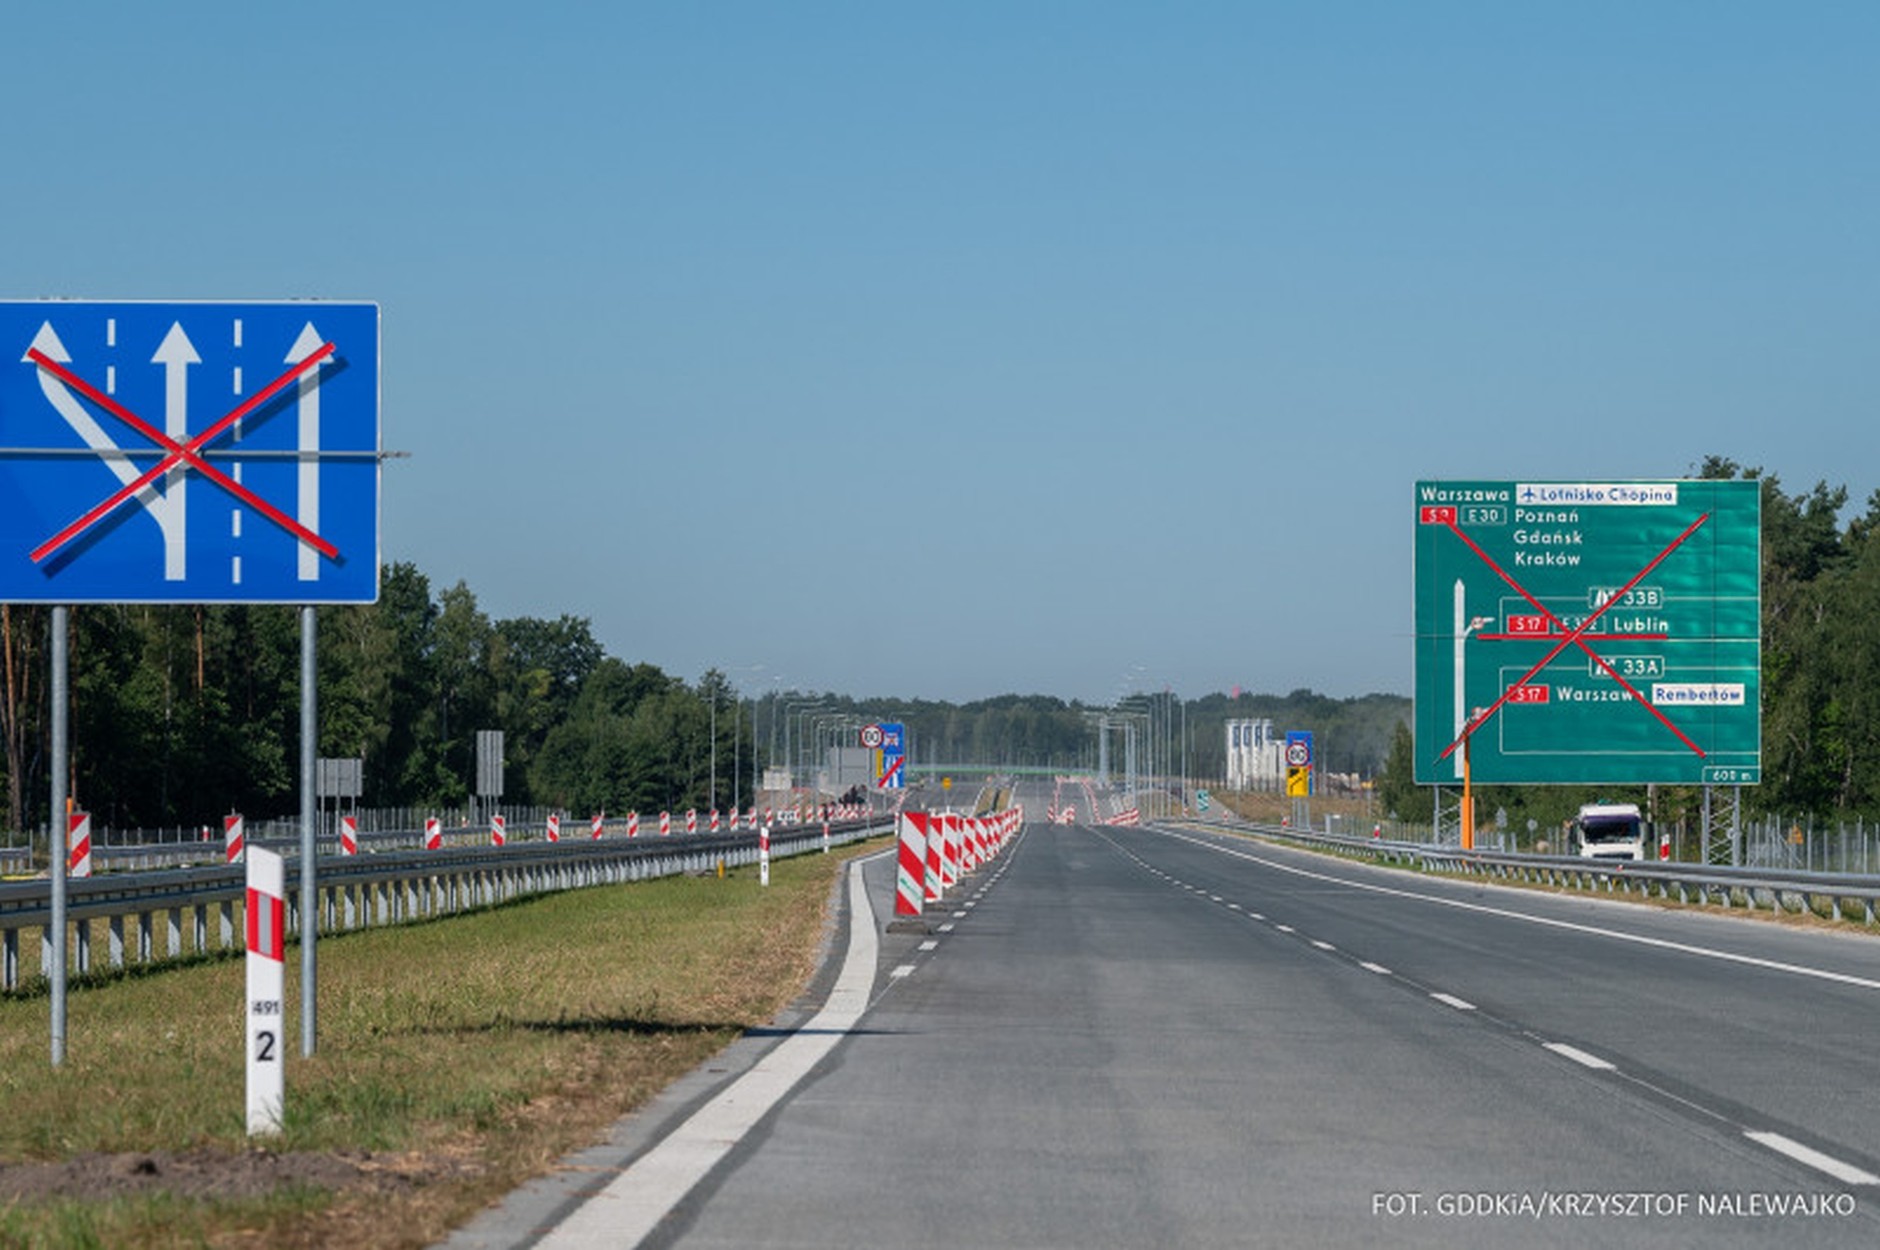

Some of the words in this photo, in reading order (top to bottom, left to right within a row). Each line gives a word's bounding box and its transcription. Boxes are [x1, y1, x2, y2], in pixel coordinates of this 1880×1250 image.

[1421, 486, 1509, 501] Warszawa
[1540, 487, 1604, 501] Lotnisko
[1609, 487, 1673, 503] Chopina
[1514, 508, 1579, 524] Poznań
[1514, 530, 1583, 546] Gdańsk
[1515, 551, 1581, 567] Kraków
[1614, 618, 1669, 632] Lublin
[1624, 660, 1659, 675] 33A
[1655, 686, 1740, 703] Rembertów
[253, 1001, 279, 1014] 491
[256, 1030, 275, 1062] 2
